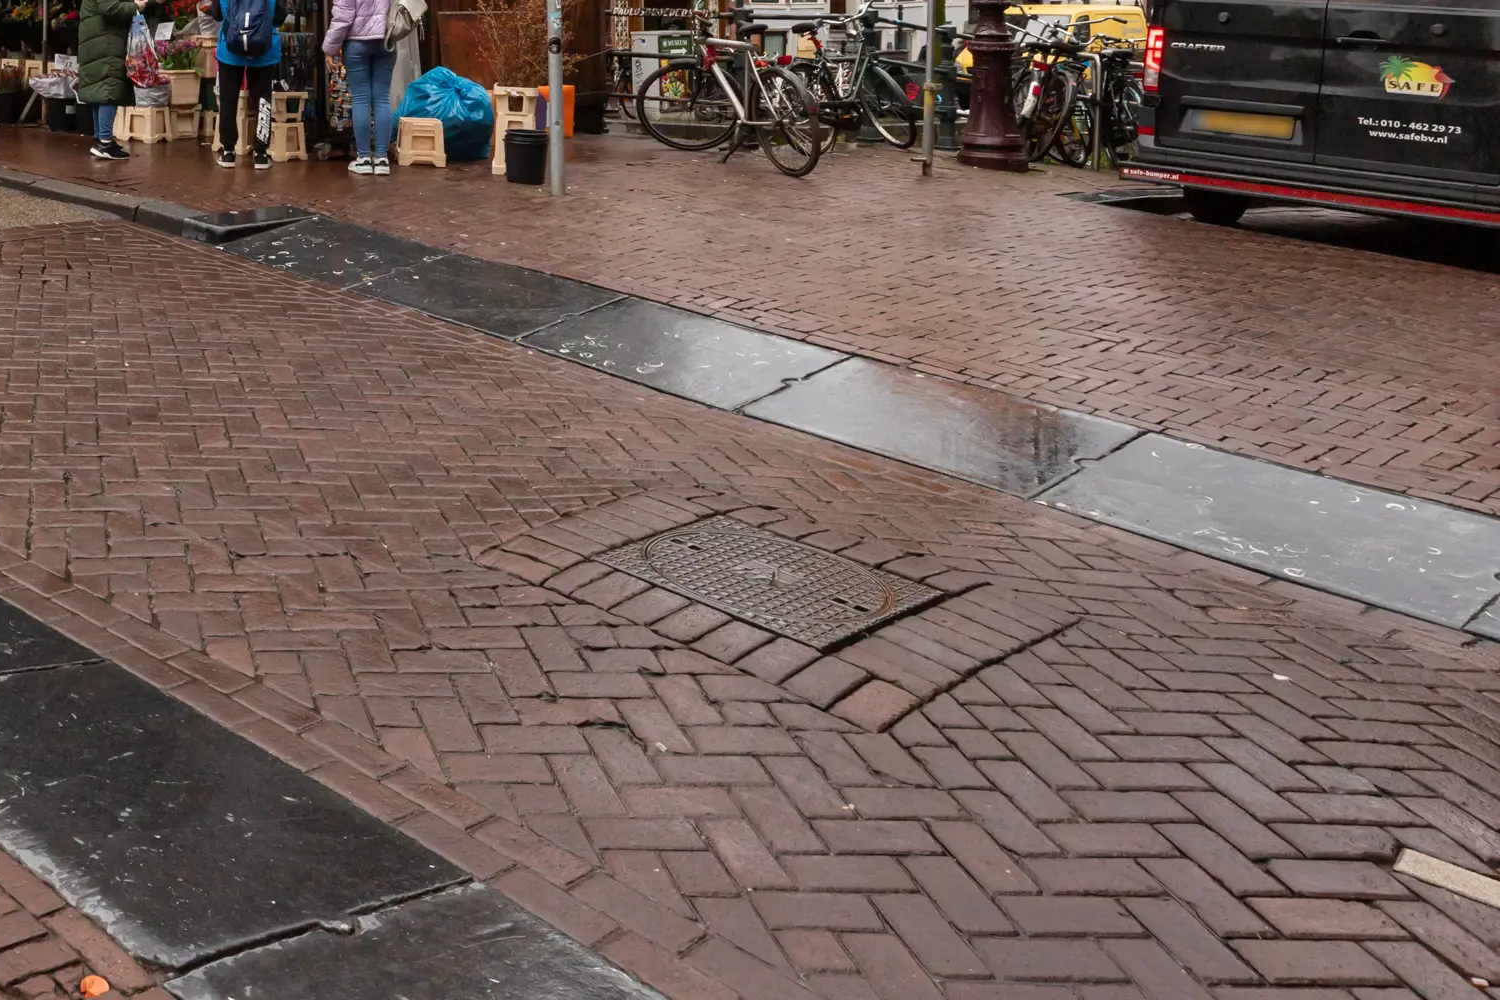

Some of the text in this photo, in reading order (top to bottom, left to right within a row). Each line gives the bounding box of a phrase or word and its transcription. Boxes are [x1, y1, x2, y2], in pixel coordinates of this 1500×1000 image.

[1171, 42, 1225, 52] CRAFTER
[1388, 80, 1441, 93] SAFE
[1358, 117, 1379, 127] Tel.:
[1380, 119, 1401, 129] 010
[1409, 122, 1430, 132] 462
[1431, 124, 1446, 133] 29
[1448, 125, 1462, 134] 73
[1369, 130, 1449, 144] www.safebv.nl
